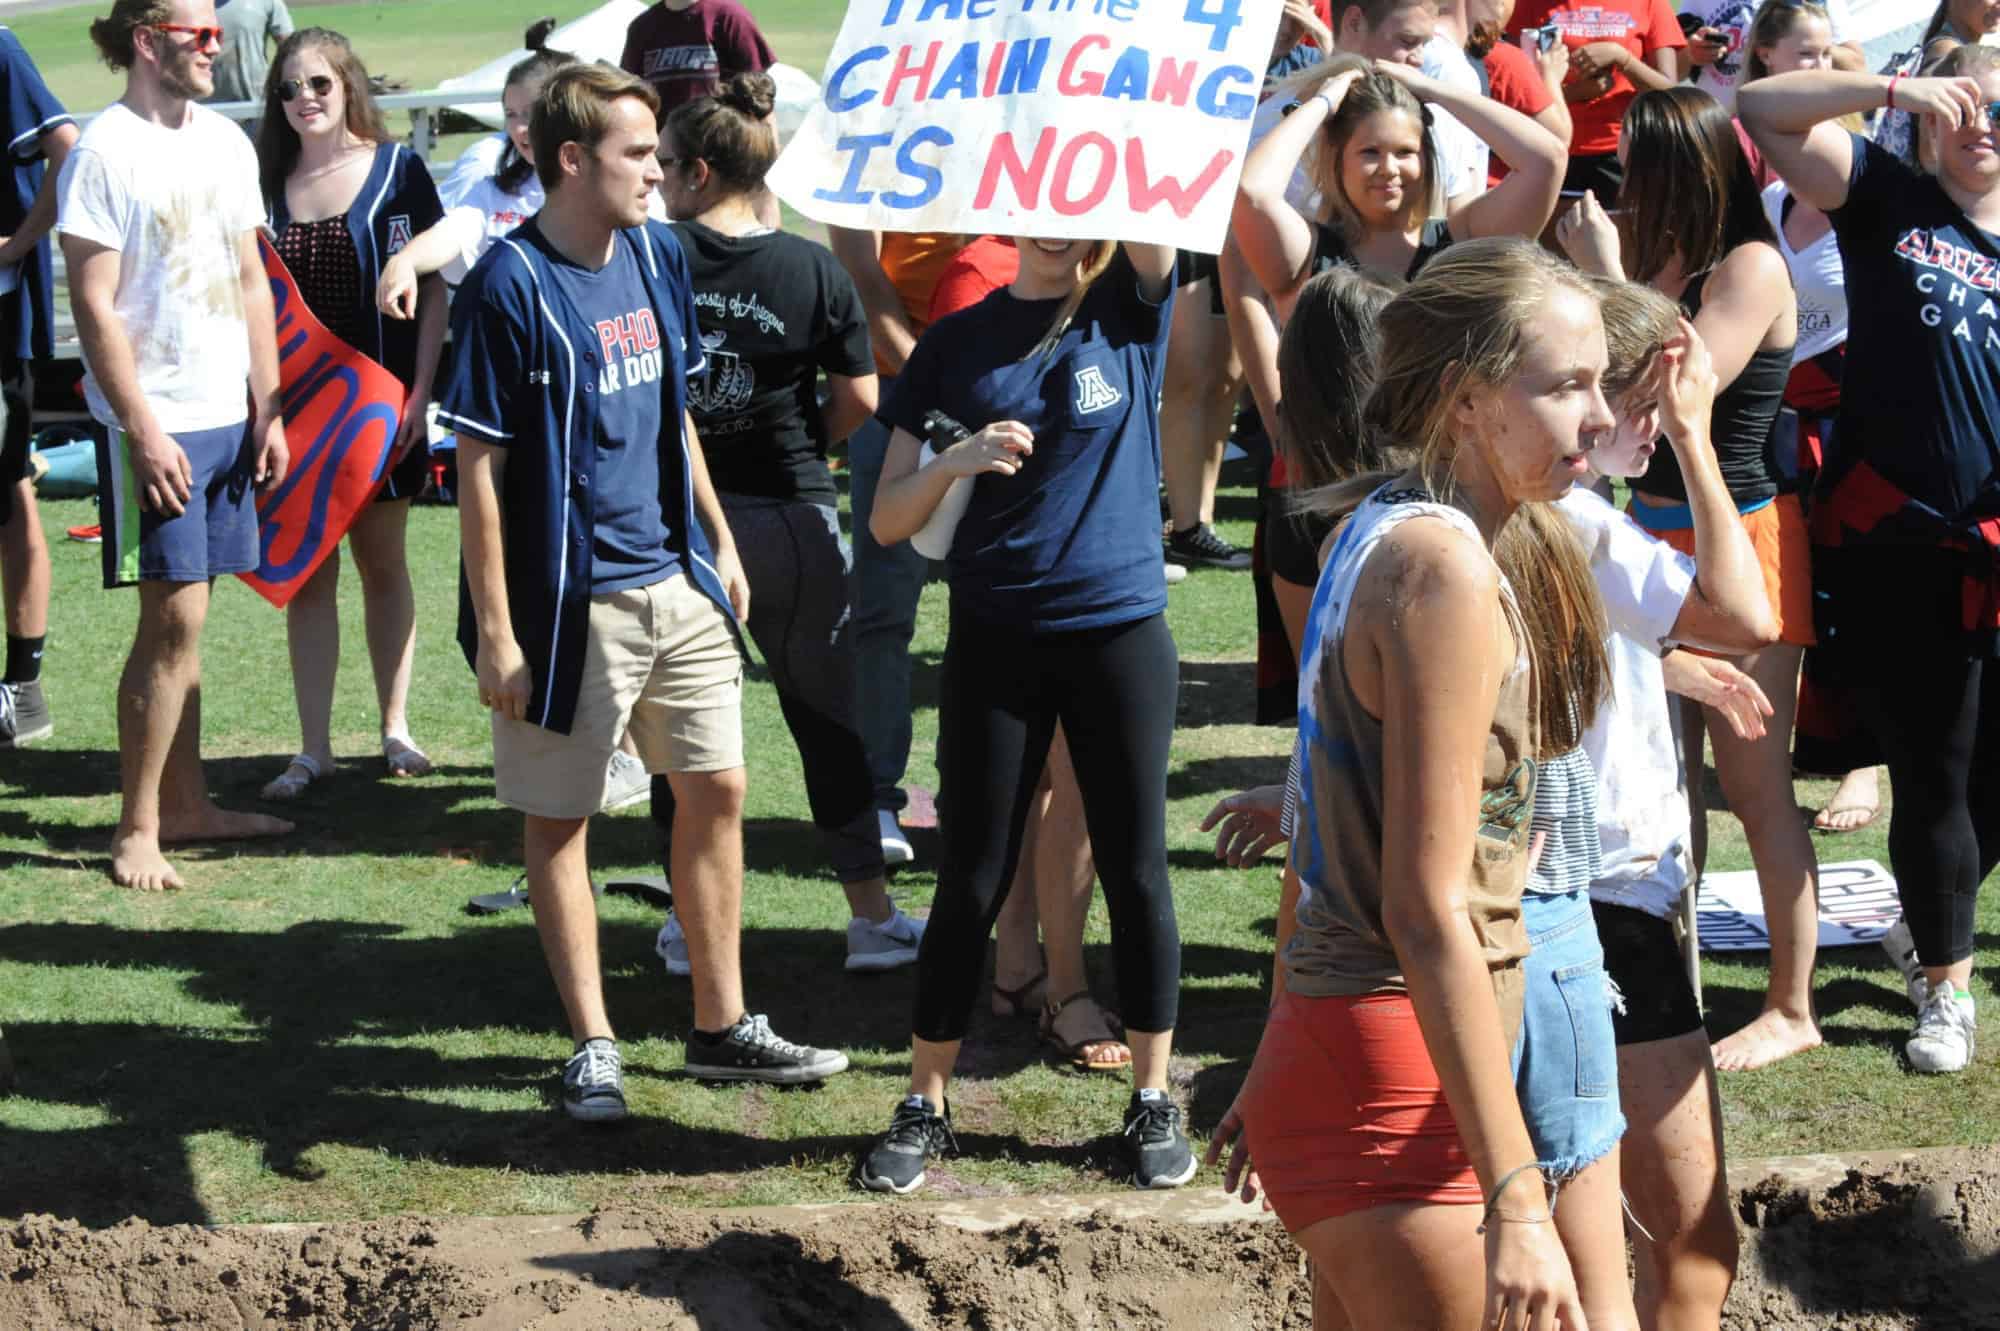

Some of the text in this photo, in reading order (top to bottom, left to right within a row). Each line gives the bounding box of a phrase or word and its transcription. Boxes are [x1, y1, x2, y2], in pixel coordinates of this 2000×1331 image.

[825, 34, 1256, 120] CHAIN GANG
[813, 125, 1235, 219] IS NOW
[1894, 228, 2000, 292] ARIZ
[692, 292, 726, 318] versity
[1797, 312, 1831, 330] EGA
[588, 308, 660, 364] PHO
[599, 363, 622, 395] AR
[1074, 365, 1122, 414] A
